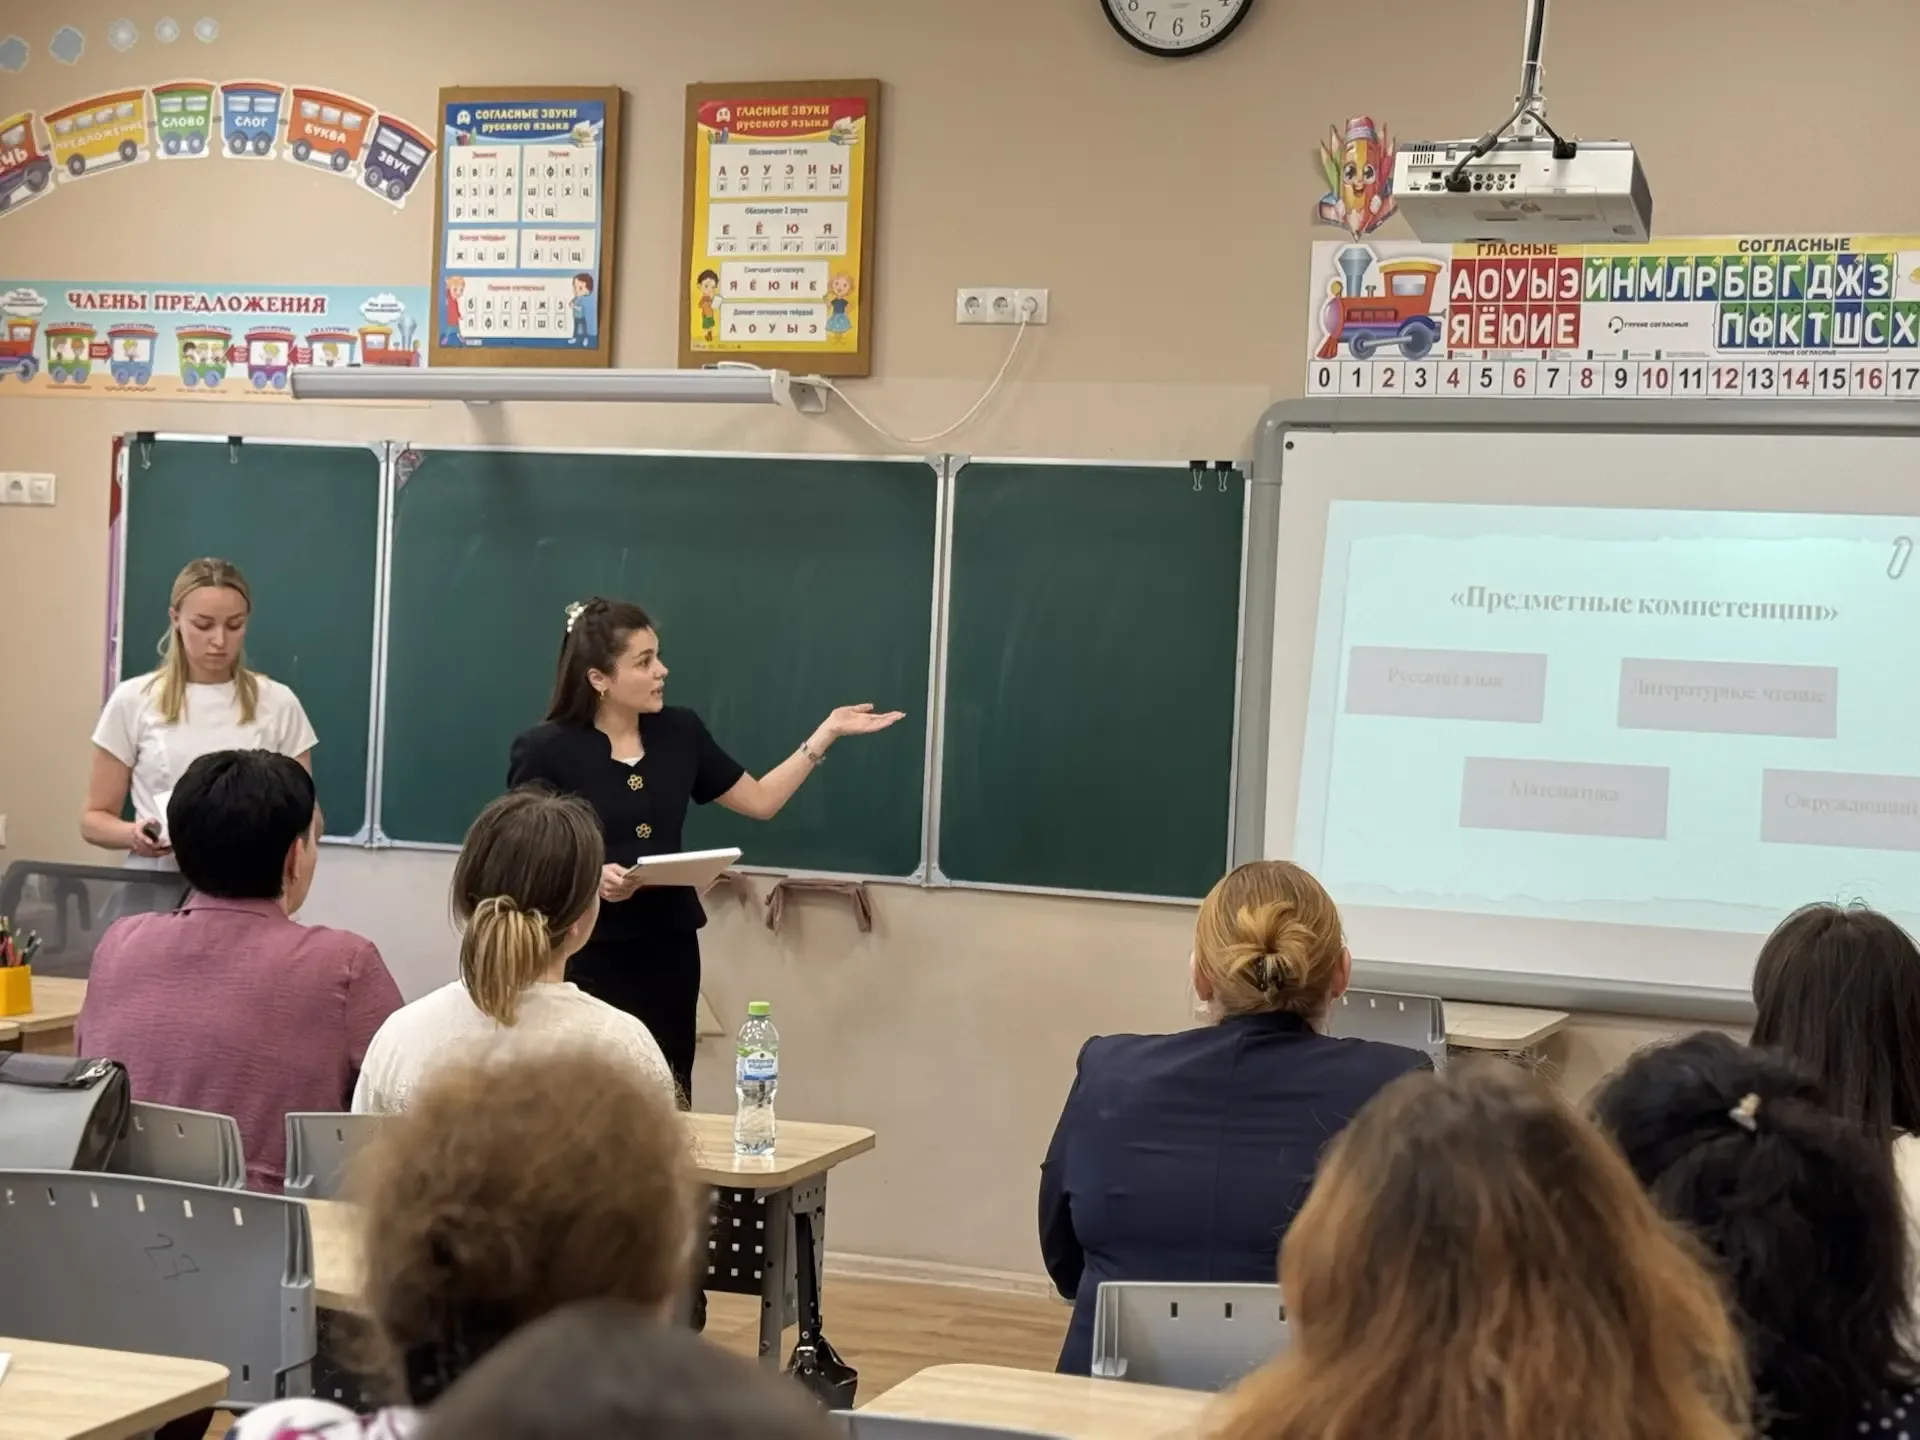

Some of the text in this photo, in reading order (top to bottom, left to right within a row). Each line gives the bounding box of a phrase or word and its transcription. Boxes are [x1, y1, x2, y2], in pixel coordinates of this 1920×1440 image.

[1146, 11, 1156, 30] 7
[1200, 9, 1211, 28] 5
[1172, 17, 1184, 36] 6
[475, 108, 577, 120] СОГЛАСНЫЕ ЗВУКИ
[736, 105, 829, 117] ГЛАСНЫЕ ЗВУКИ
[161, 115, 205, 128] СЛОВО
[235, 115, 268, 128] СЛОГ
[482, 121, 569, 133] русского языка
[736, 119, 828, 131] русского языка
[304, 123, 346, 144] БУКВА
[377, 150, 411, 176] ЗВУК
[719, 164, 842, 176] А О У Э И Ы
[722, 222, 832, 235] Е Ё Ю Я
[1477, 243, 1558, 256] ГЛАСНЫЕ
[1738, 238, 1850, 253] СОГЛАСНЫЕ
[68, 293, 147, 310] ЧЛЕНЫ
[154, 294, 326, 314] ПРЕДЛОЖЕНИЯ
[729, 324, 817, 334] А О У Ы Э
[1318, 367, 1919, 388] 0 1 2 3 4 5 6 7 8 9 10 11 12 13 14 15 16 17
[1450, 585, 1632, 615] «Предметные
